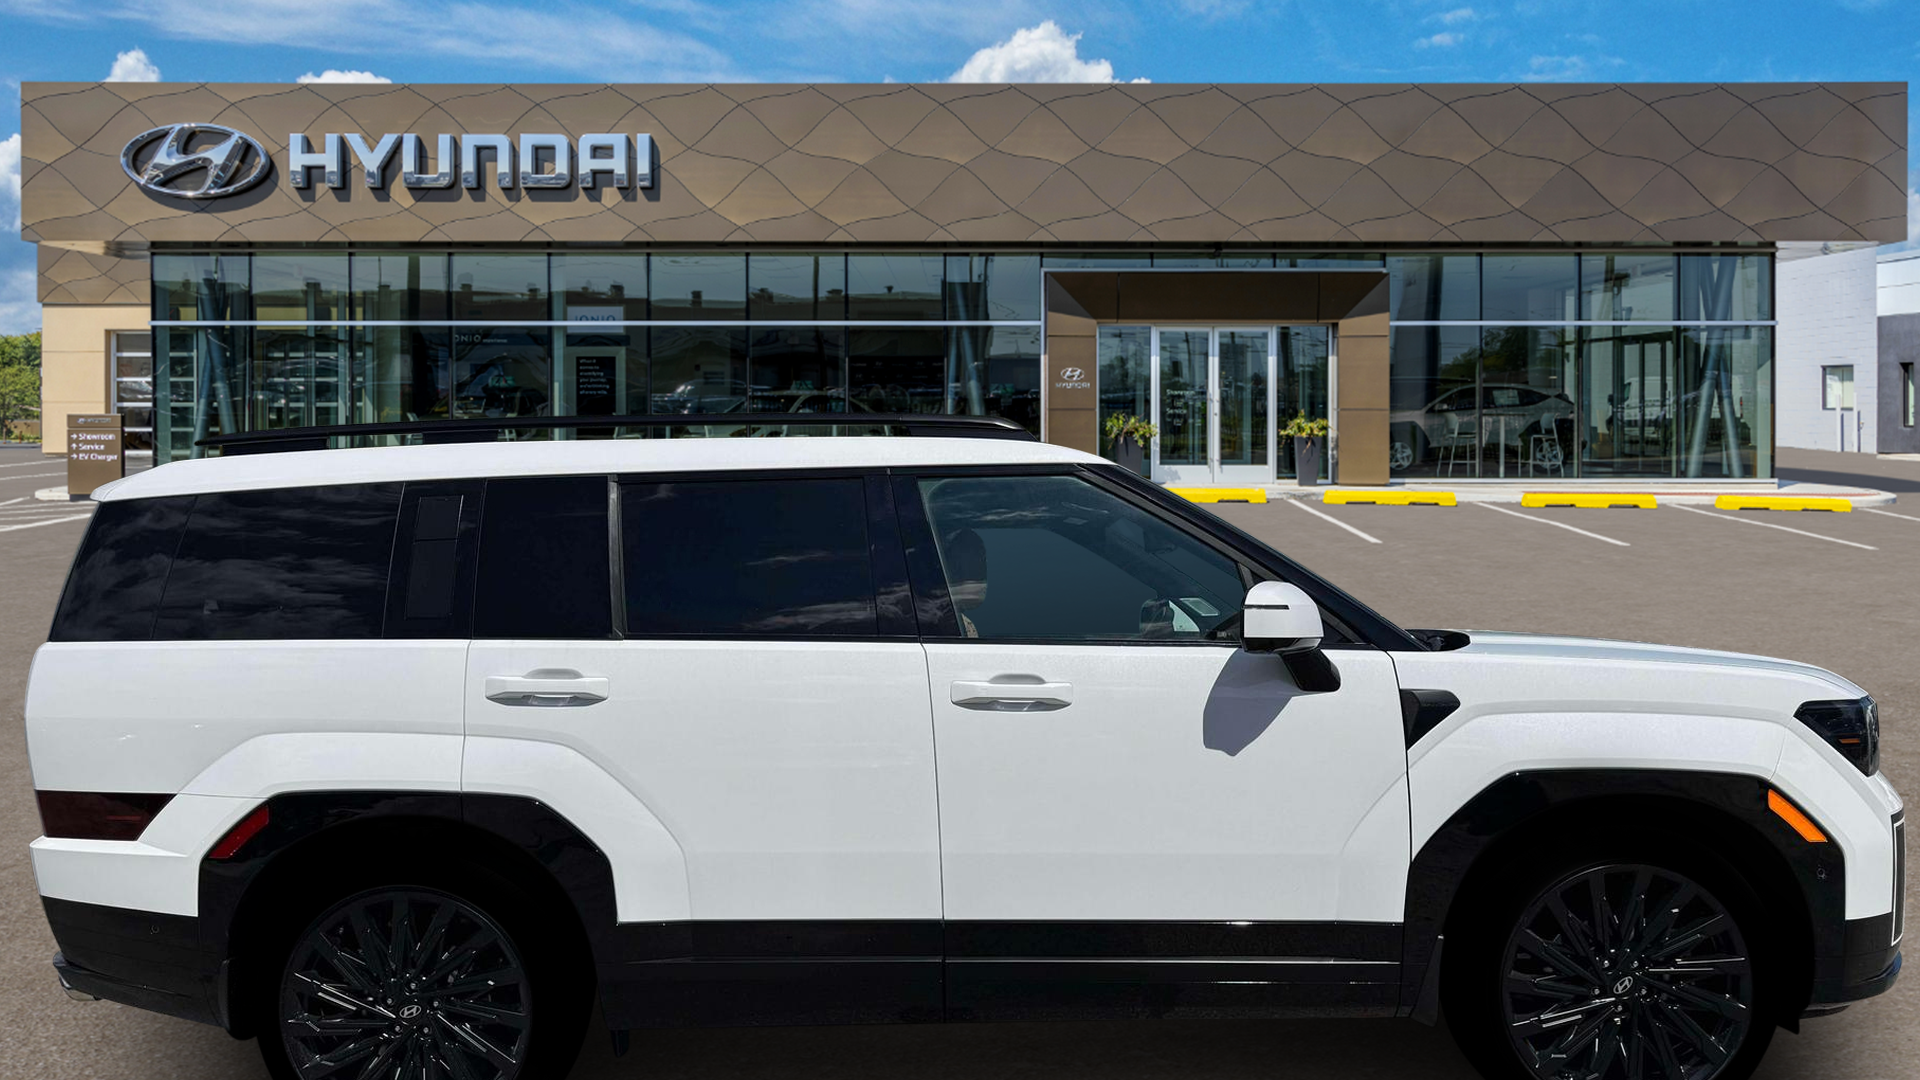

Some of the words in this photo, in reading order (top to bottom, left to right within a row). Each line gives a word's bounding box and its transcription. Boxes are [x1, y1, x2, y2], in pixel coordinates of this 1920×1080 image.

[289, 133, 655, 189] HYUNDAI
[78, 432, 116, 441] Showroom
[78, 442, 105, 450] Service
[78, 452, 90, 460] EV
[90, 452, 118, 462] Charger
